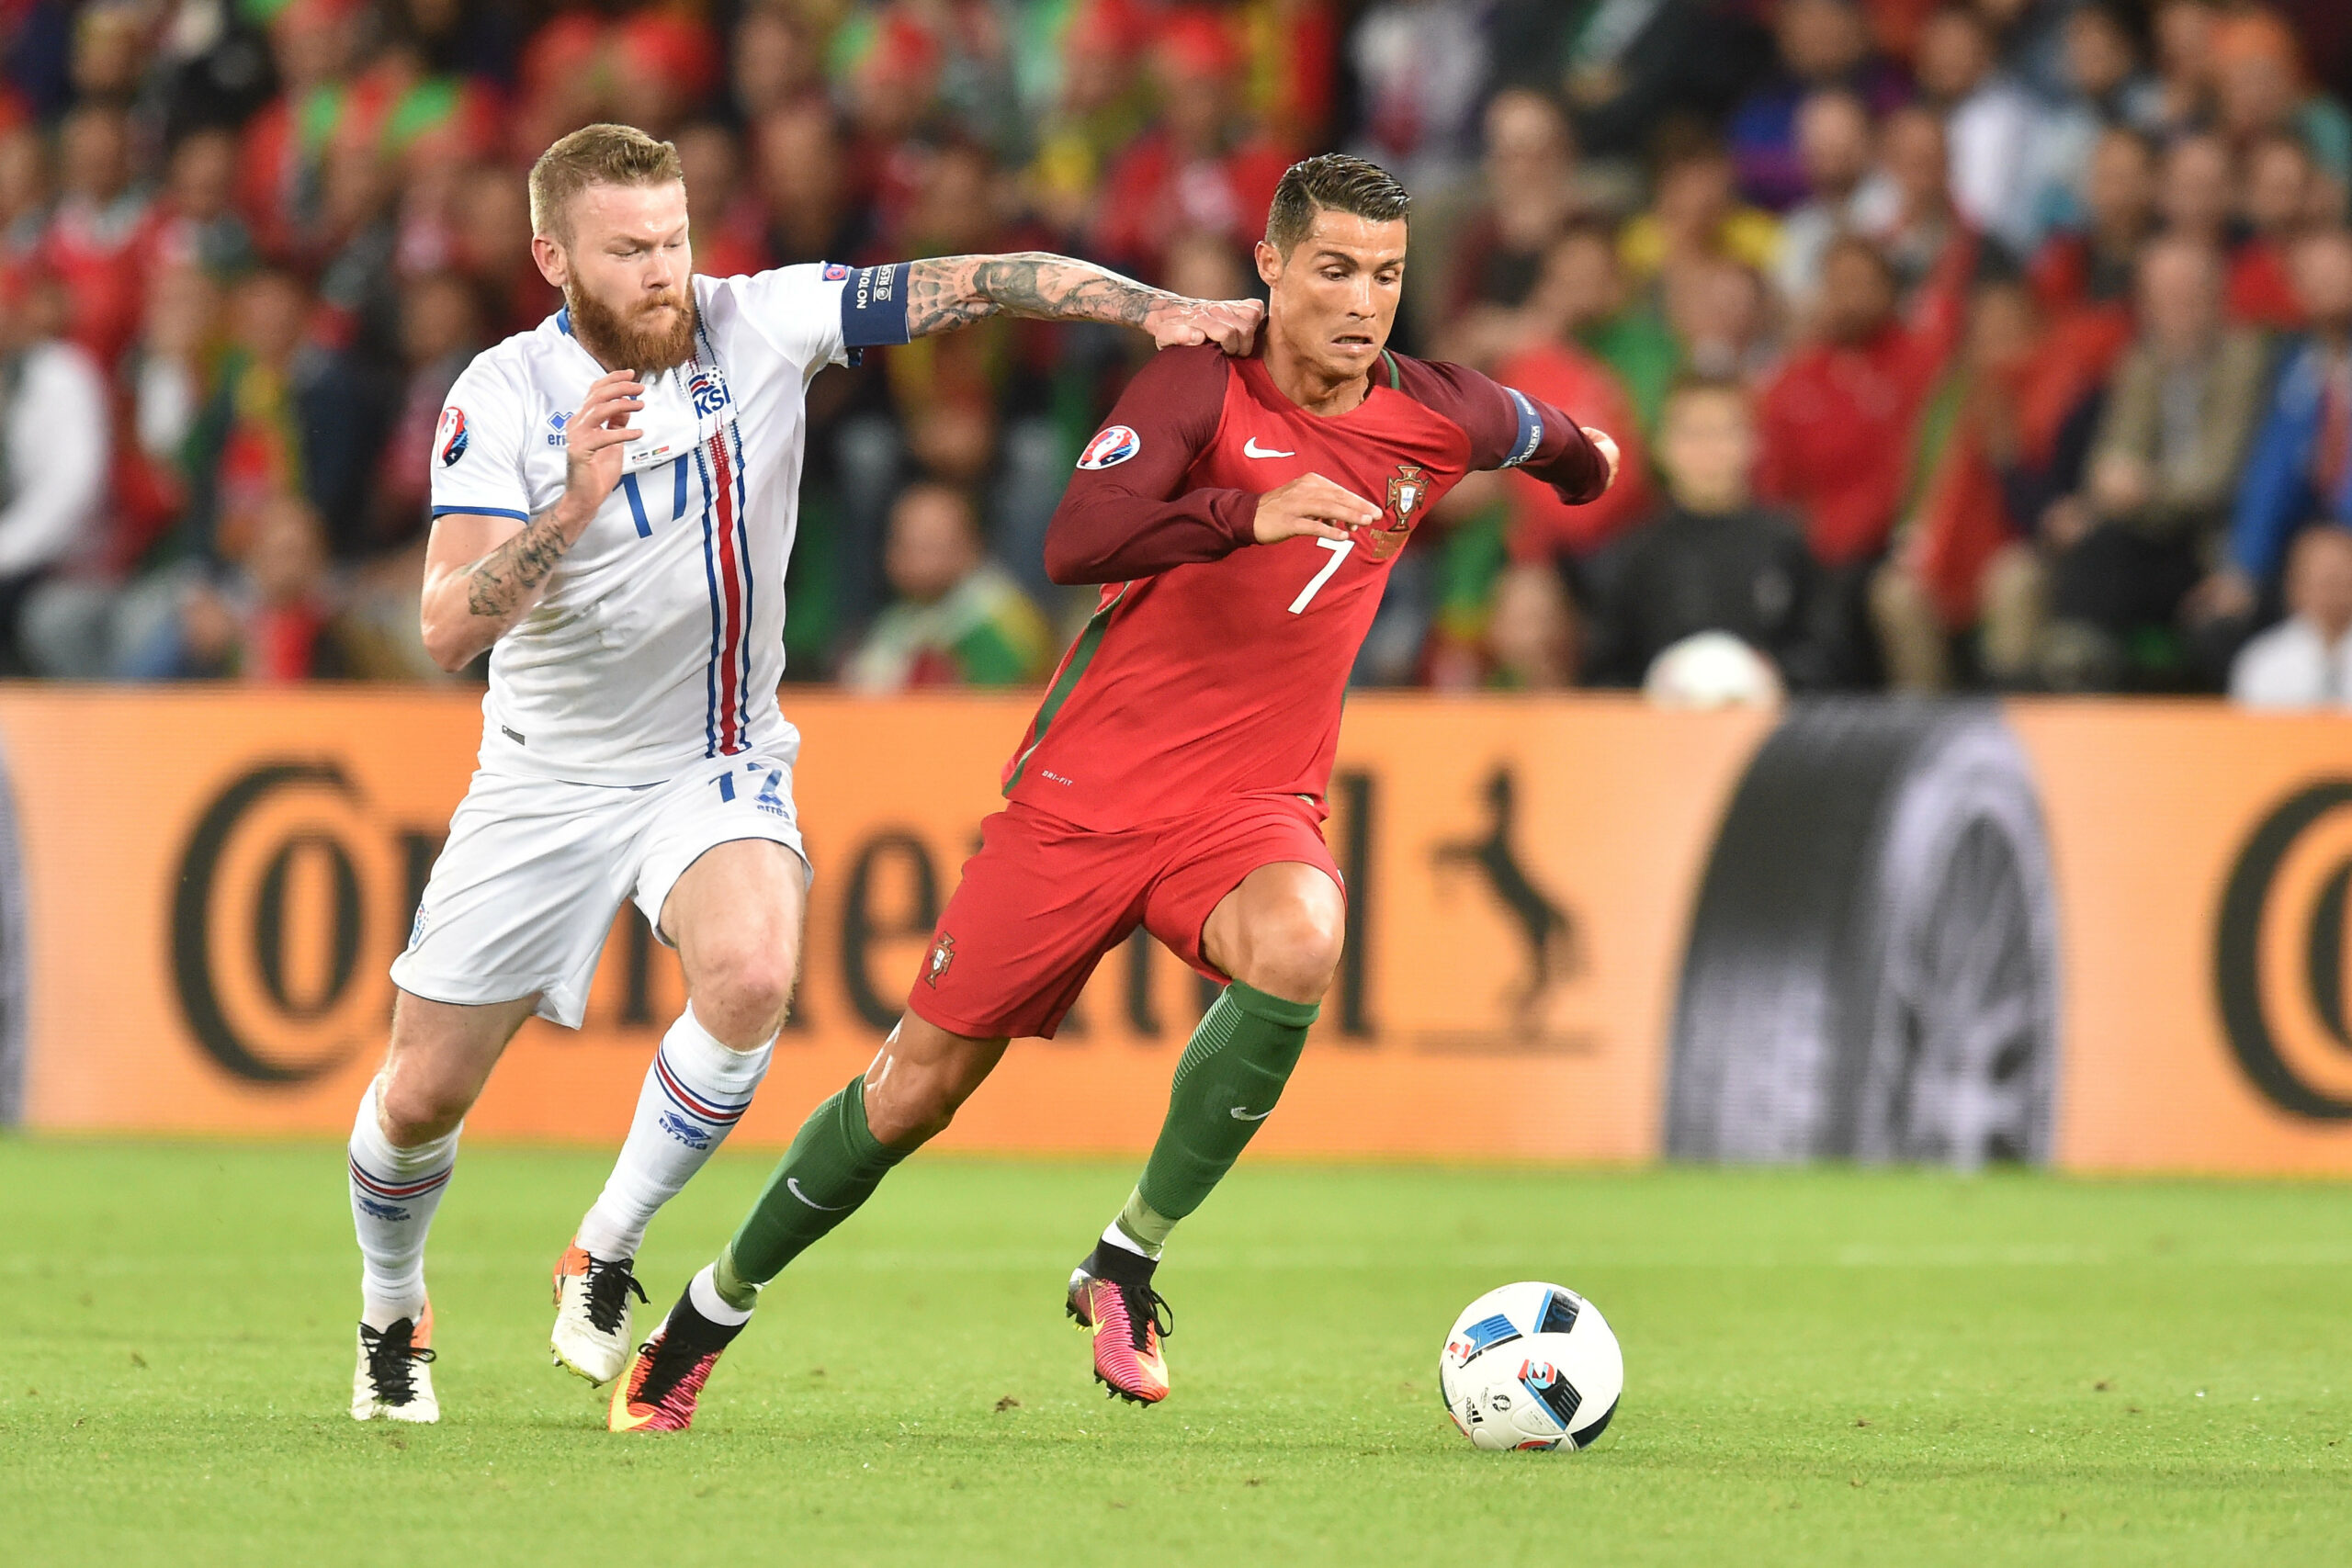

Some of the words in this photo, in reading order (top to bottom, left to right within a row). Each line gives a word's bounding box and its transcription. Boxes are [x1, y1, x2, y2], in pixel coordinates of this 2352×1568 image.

[856, 289, 868, 309] NO
[613, 453, 688, 539] 17
[1287, 536, 1355, 615] 7
[708, 761, 782, 803] 17
[1041, 770, 1073, 787] DRI-FIT
